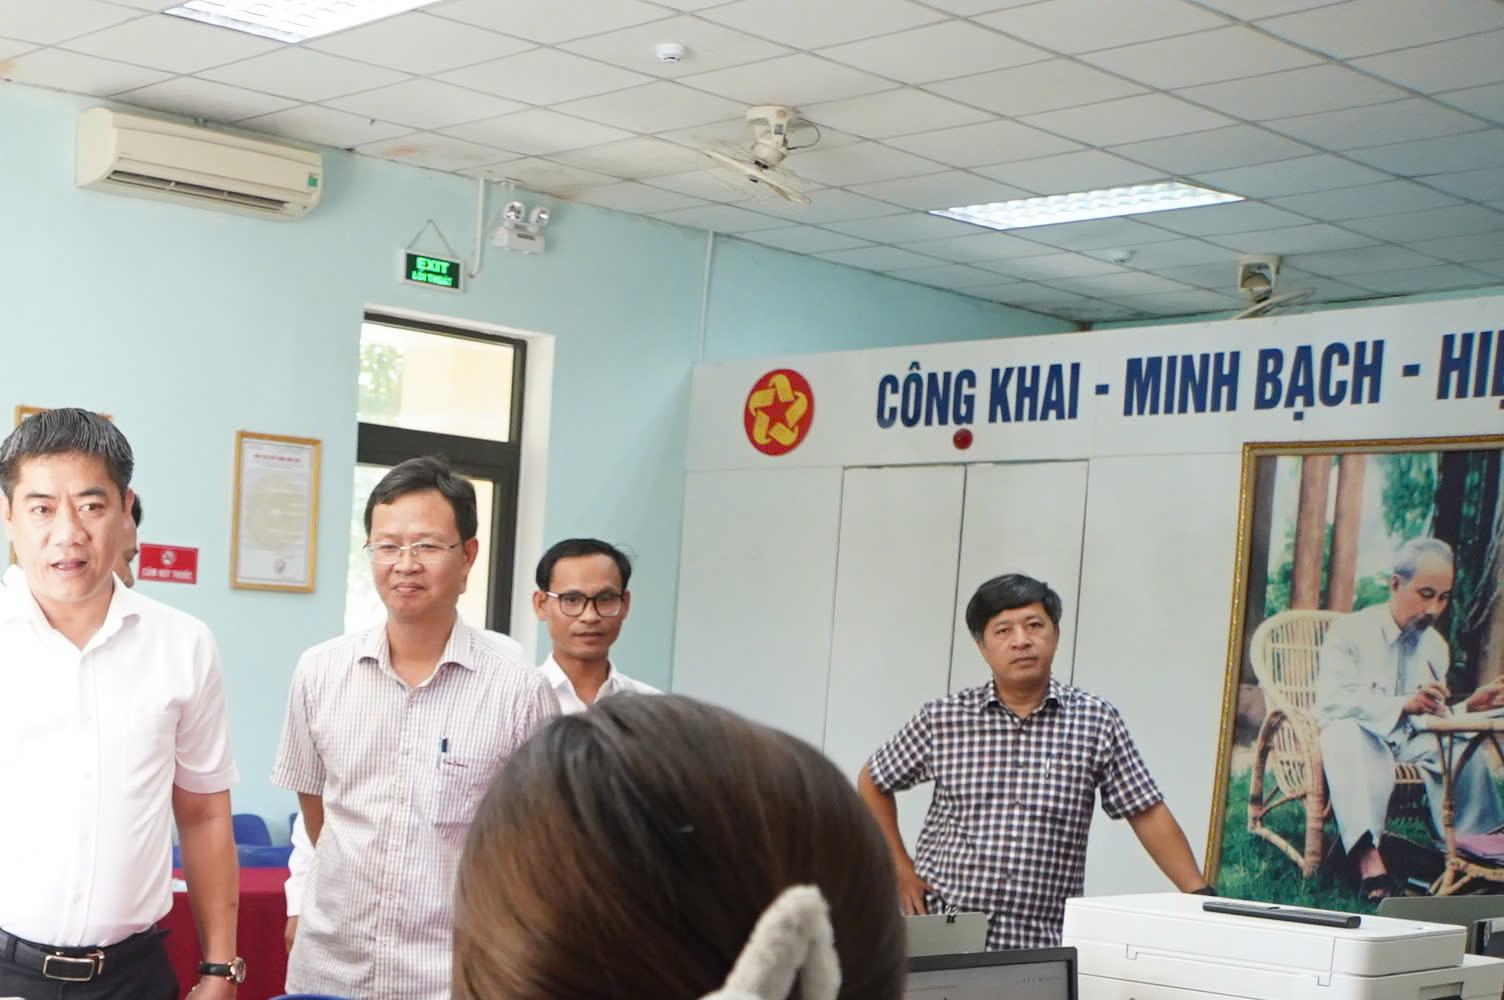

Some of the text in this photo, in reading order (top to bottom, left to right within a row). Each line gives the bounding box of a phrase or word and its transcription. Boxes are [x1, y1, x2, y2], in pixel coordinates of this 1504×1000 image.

[416, 256, 450, 274] EXIT
[876, 361, 976, 430] CÔNG
[987, 362, 1081, 424] KHAI
[1122, 350, 1239, 417] MINH
[1253, 340, 1385, 421] BẠCH
[1436, 330, 1504, 409] HI
